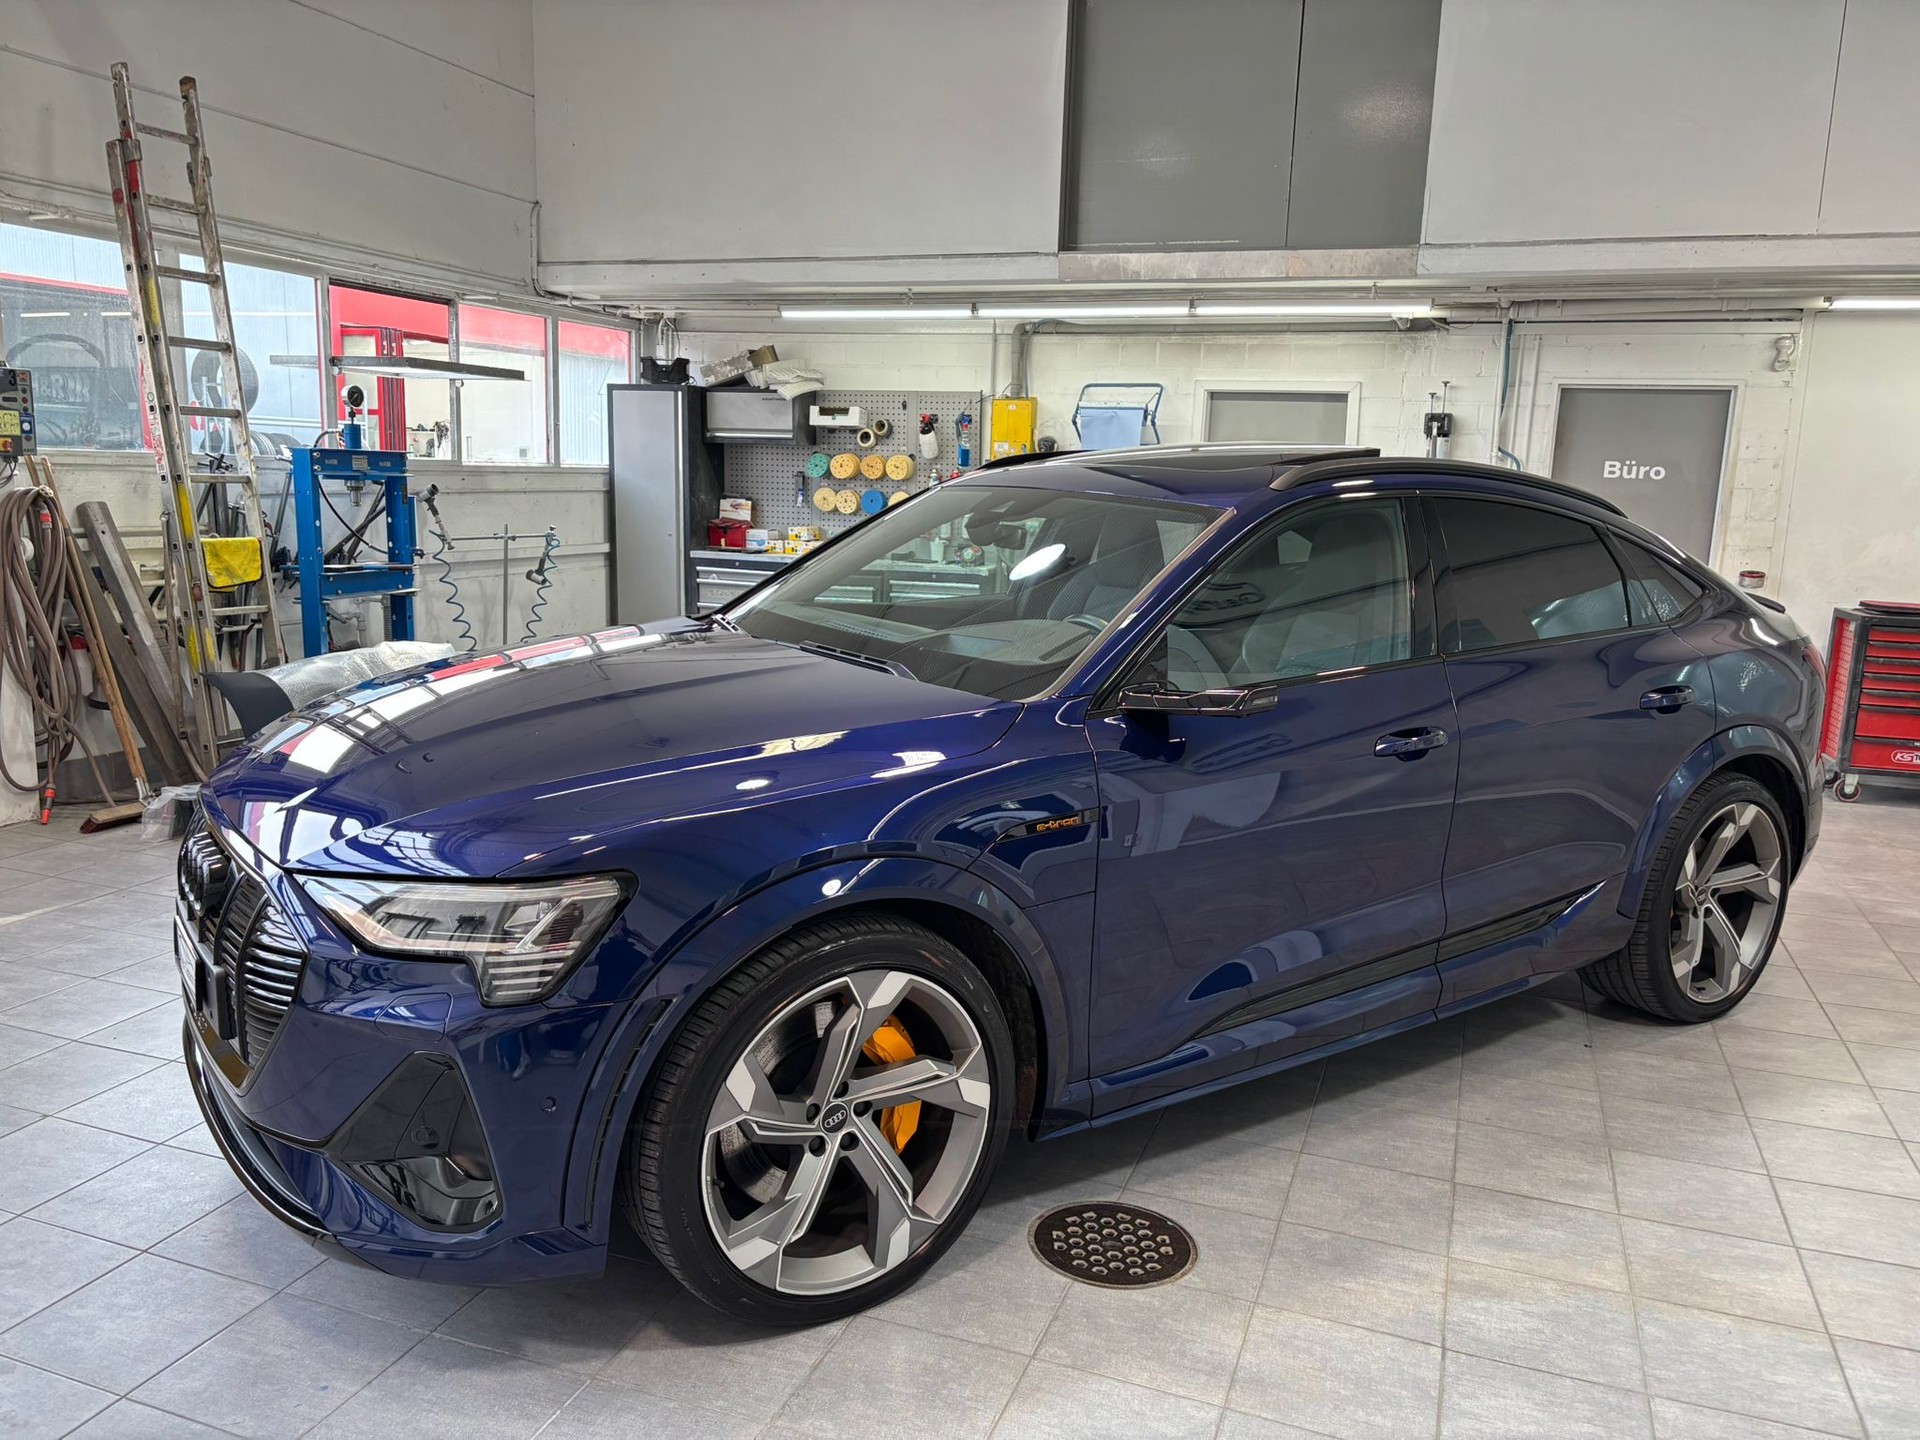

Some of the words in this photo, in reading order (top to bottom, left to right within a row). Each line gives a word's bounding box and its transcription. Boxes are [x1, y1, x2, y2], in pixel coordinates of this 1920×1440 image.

[8, 369, 17, 386] 3
[1603, 460, 1666, 480] Büro
[1895, 752, 1914, 762] KS
